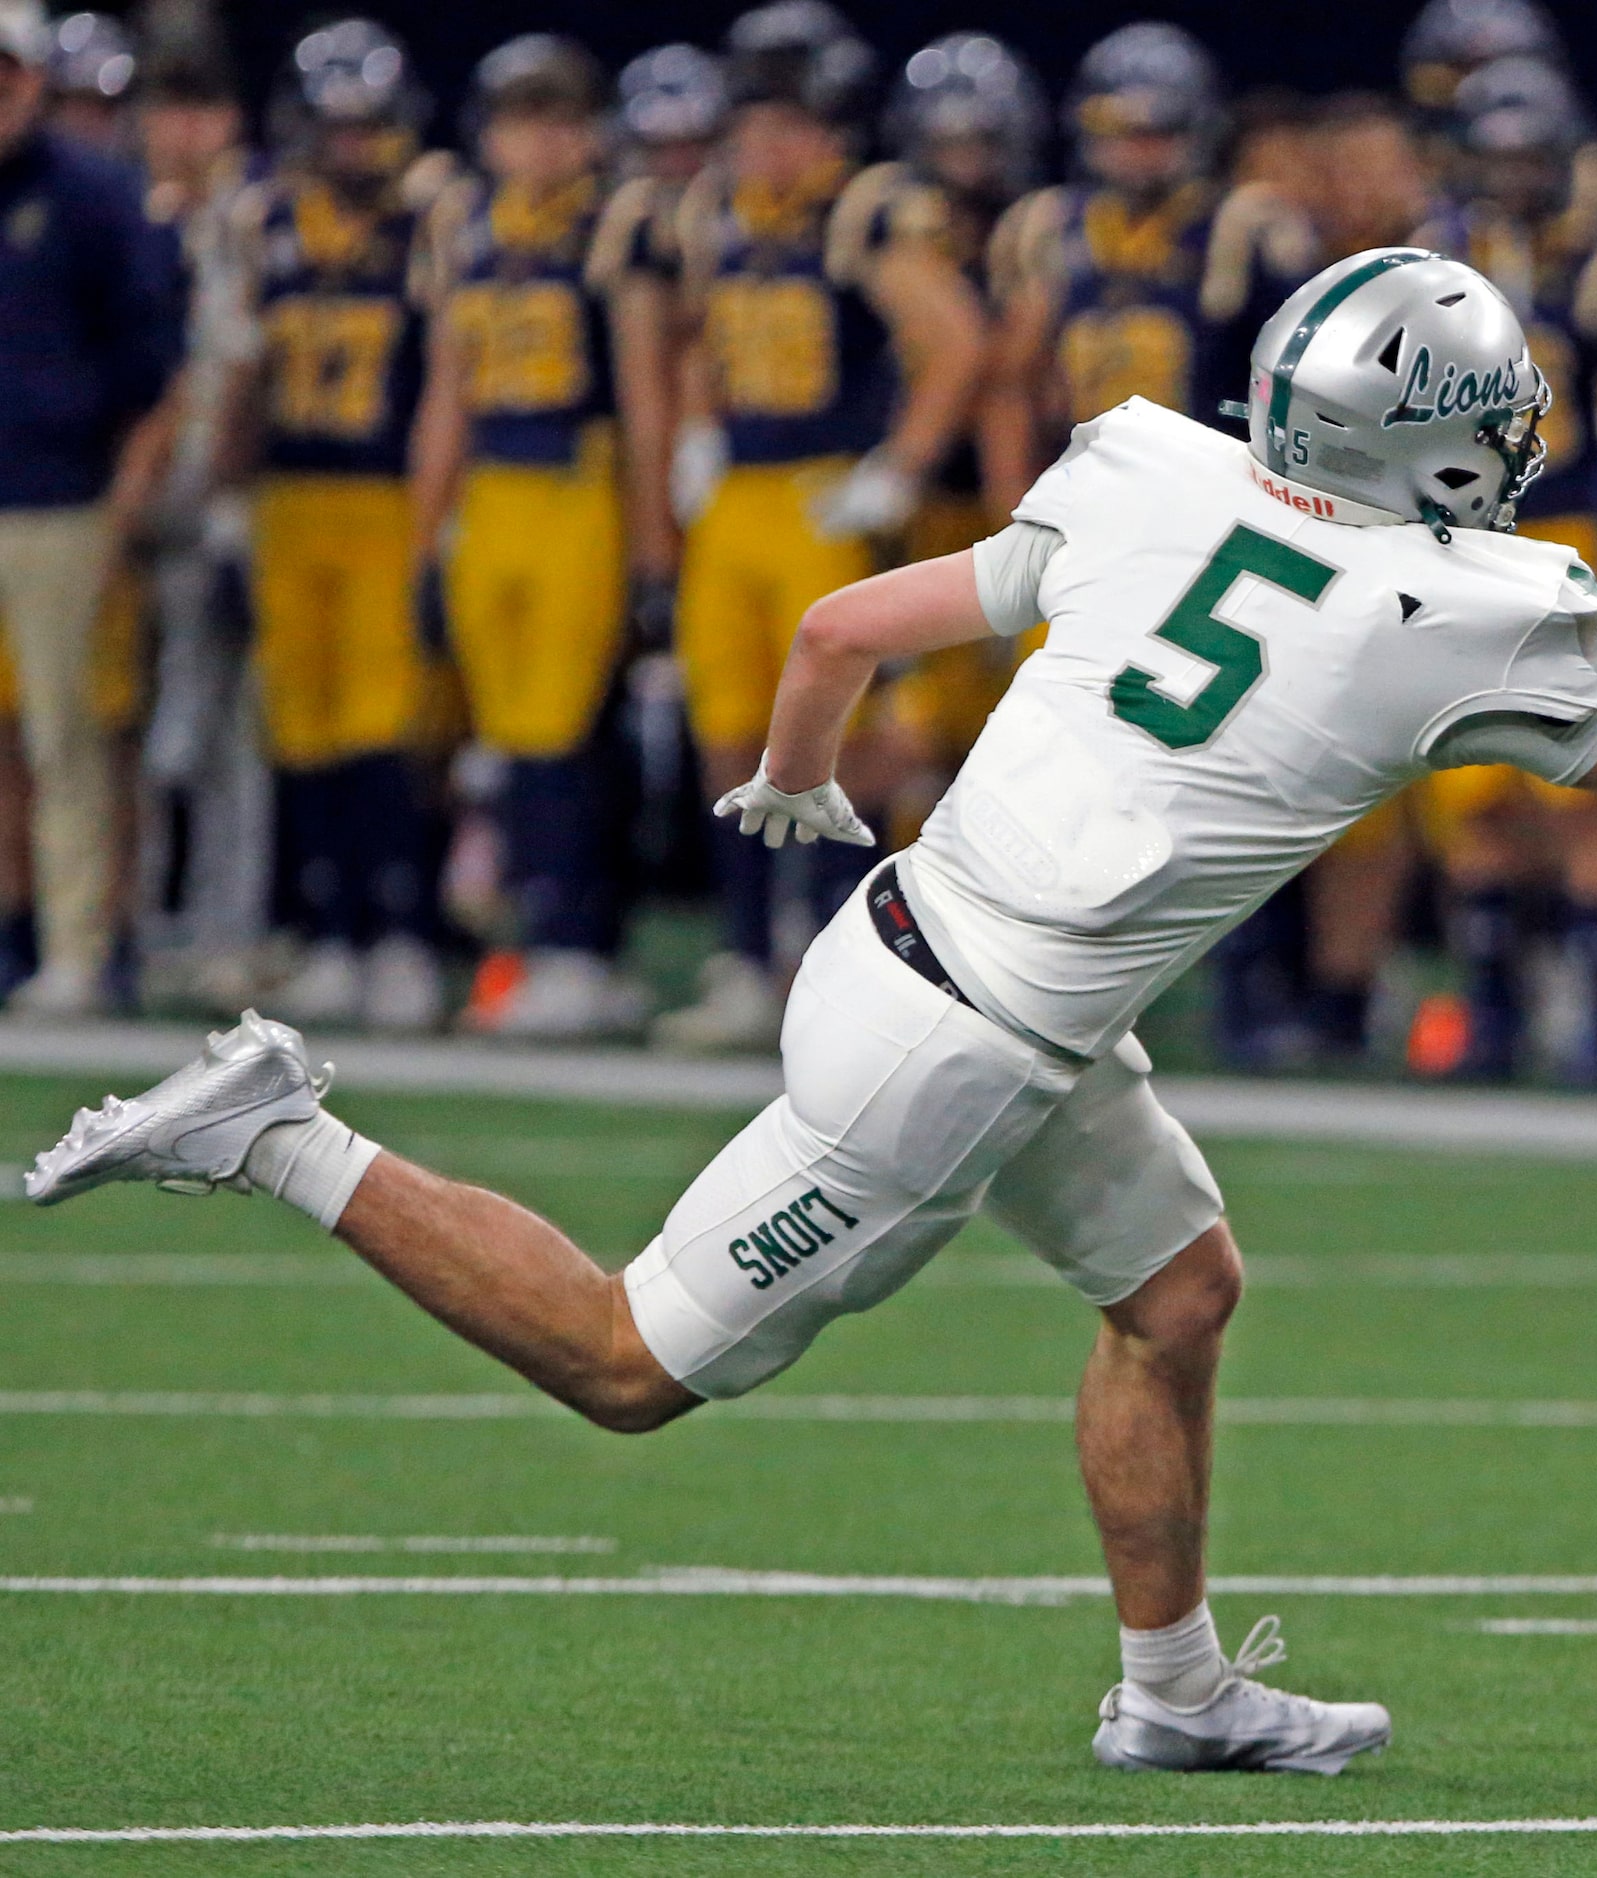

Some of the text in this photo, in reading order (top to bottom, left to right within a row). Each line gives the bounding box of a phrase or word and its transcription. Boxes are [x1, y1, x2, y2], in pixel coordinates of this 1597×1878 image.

[1380, 344, 1520, 429] Lions
[1291, 428, 1312, 467] 5
[1106, 517, 1347, 757] 5
[728, 1185, 861, 1290] LIONS
